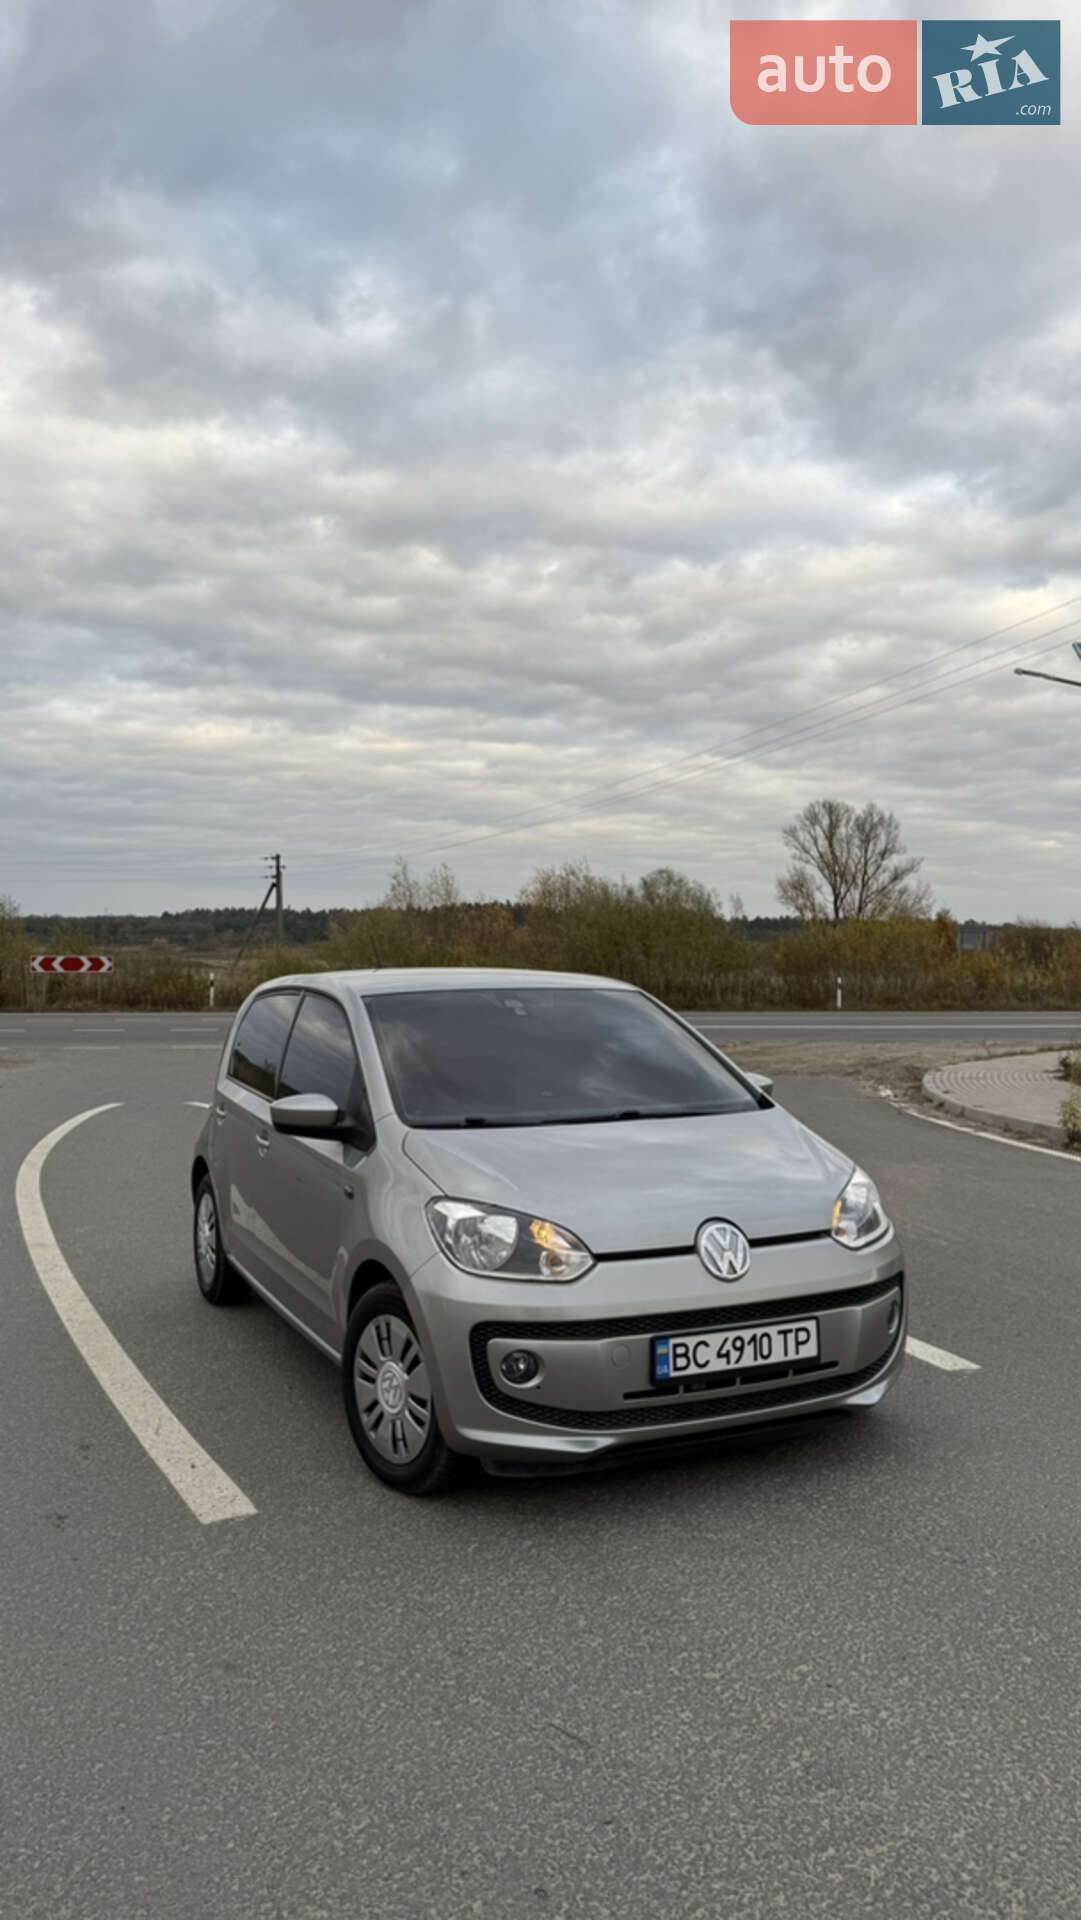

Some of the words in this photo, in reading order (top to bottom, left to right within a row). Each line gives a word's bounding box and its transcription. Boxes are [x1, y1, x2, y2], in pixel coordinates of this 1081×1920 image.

[671, 1340, 710, 1372] BC
[716, 1332, 773, 1366] 4910
[777, 1326, 811, 1358] TP
